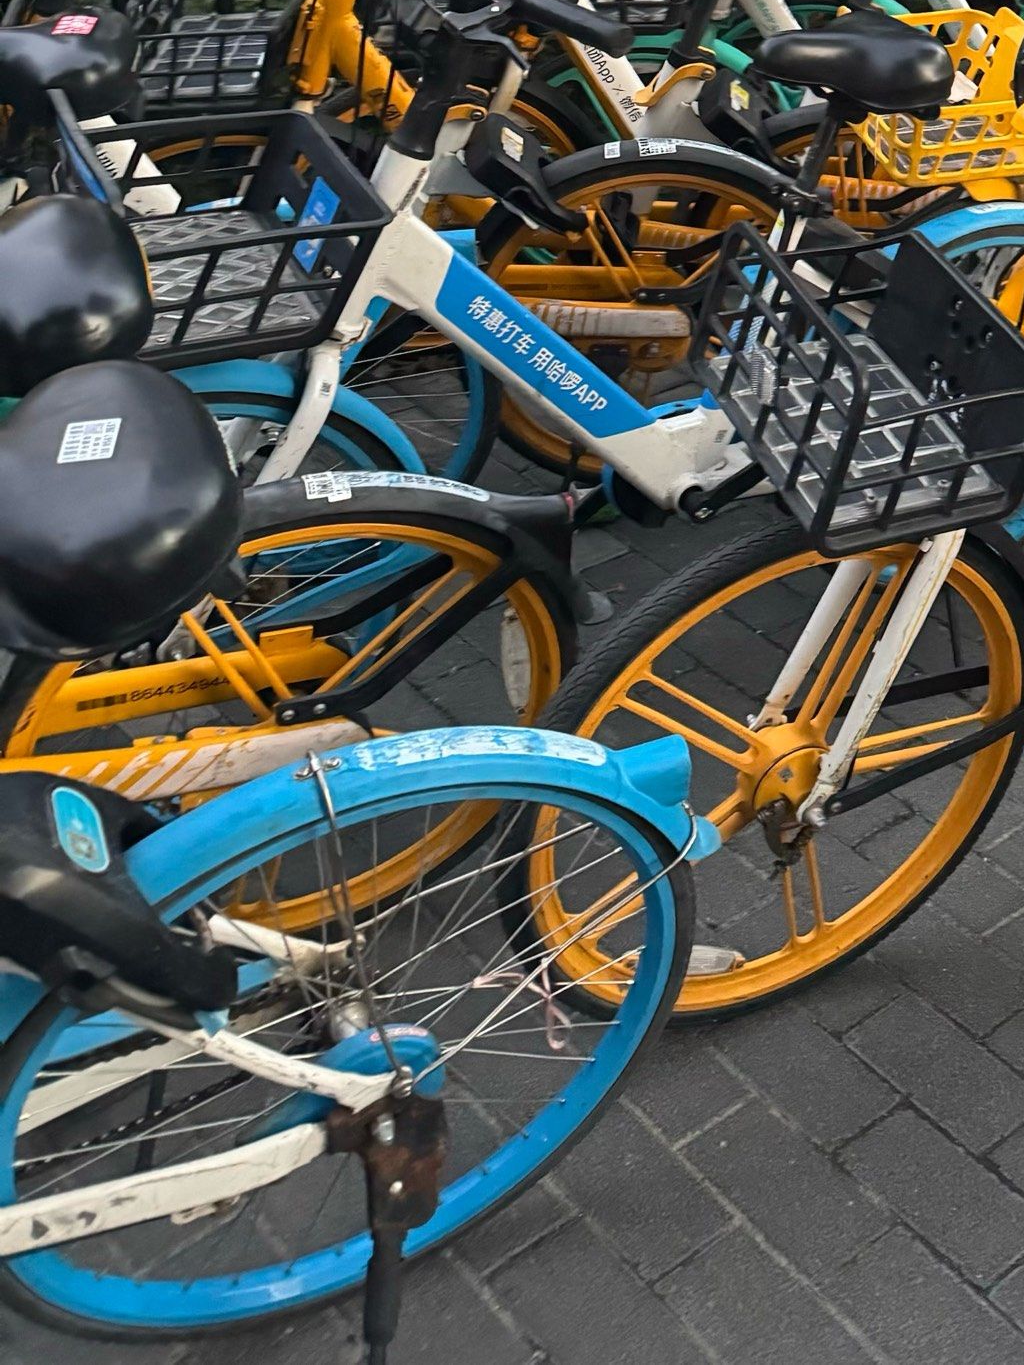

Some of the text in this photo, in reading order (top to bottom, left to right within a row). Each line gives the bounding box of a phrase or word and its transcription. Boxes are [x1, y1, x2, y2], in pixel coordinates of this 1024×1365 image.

[467, 295, 608, 412] 特惠打车 用哈啰APP
